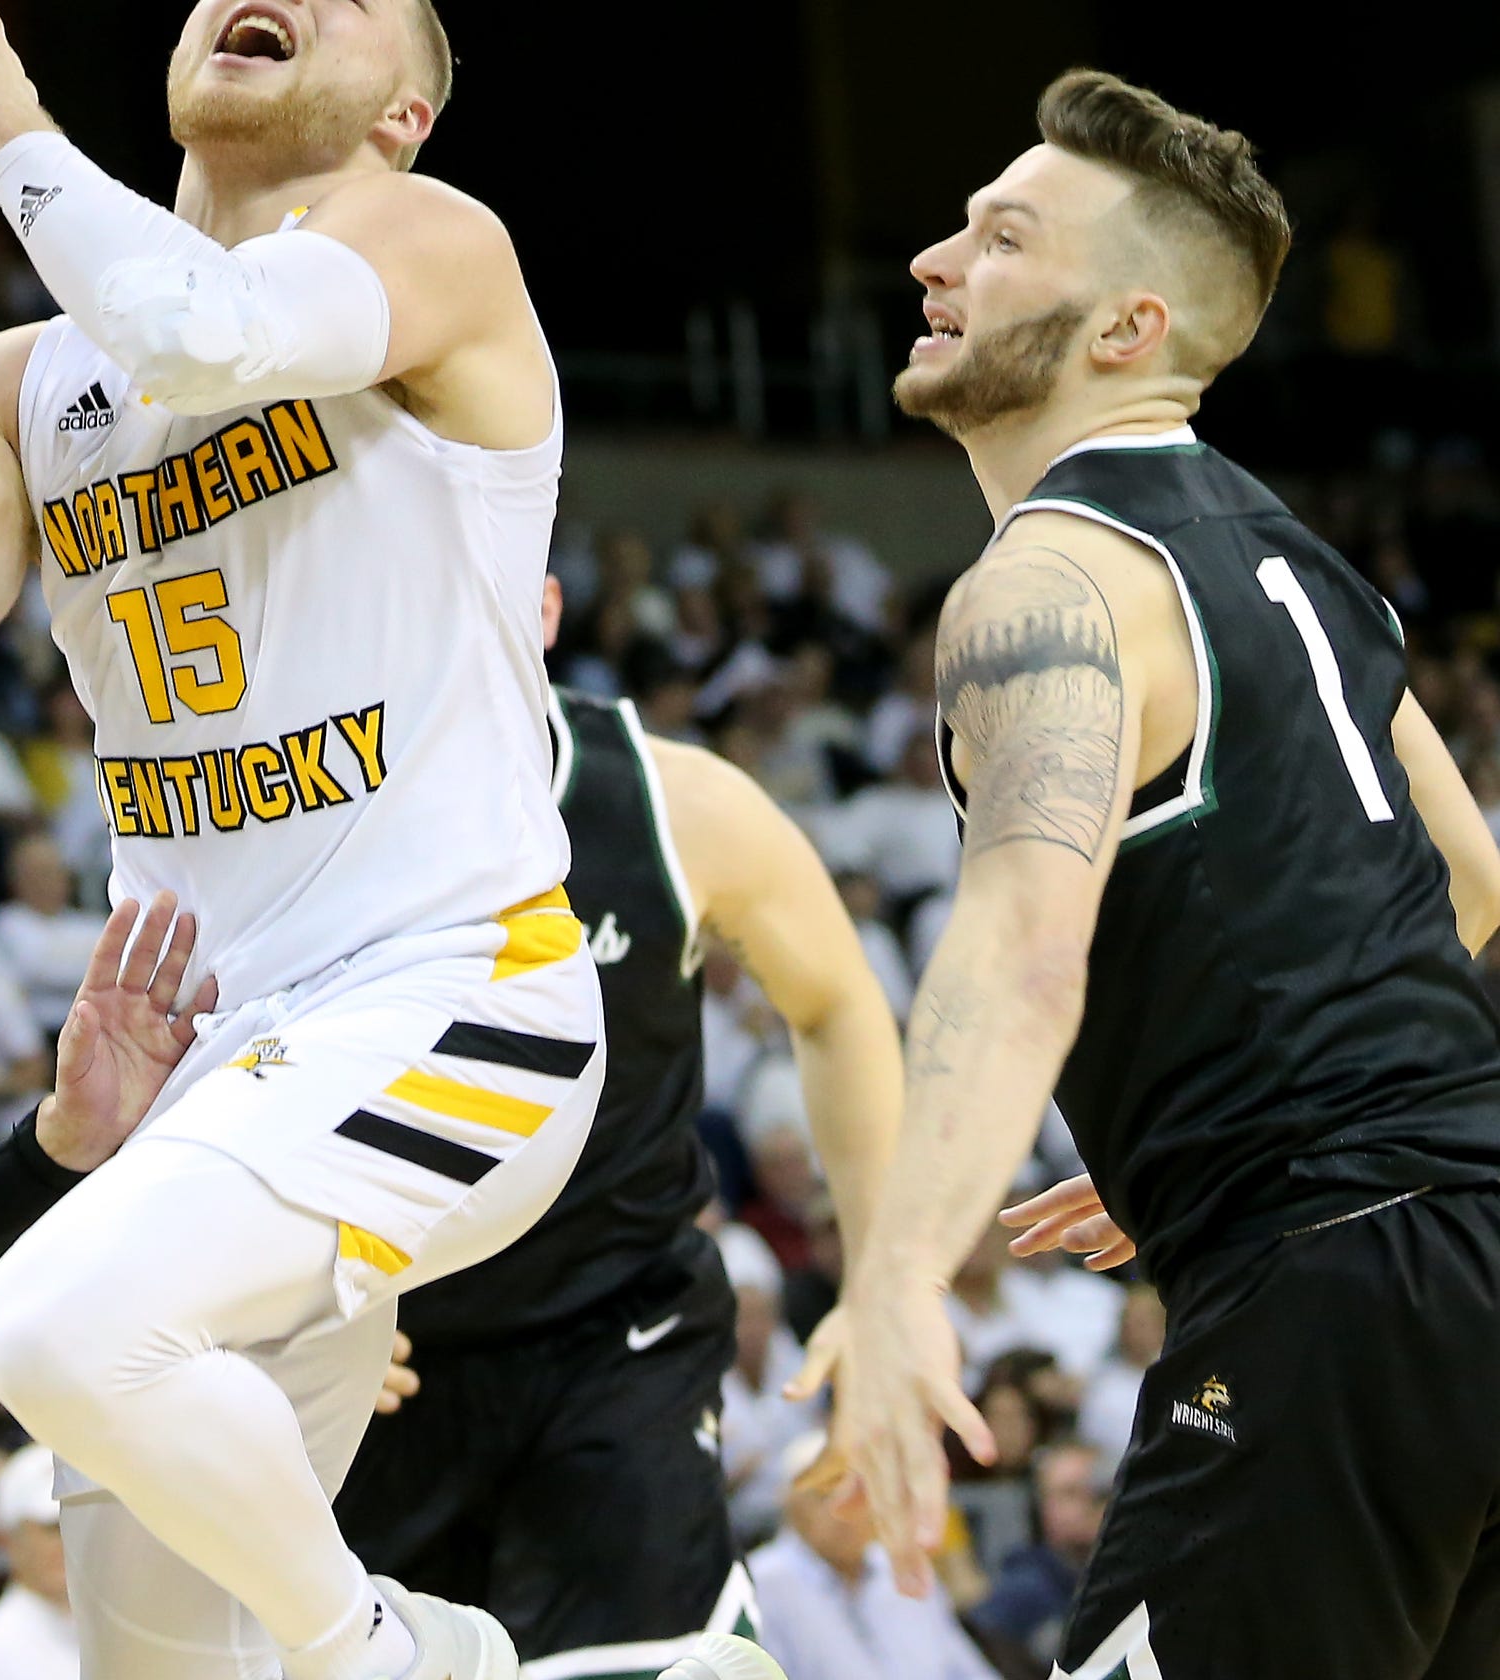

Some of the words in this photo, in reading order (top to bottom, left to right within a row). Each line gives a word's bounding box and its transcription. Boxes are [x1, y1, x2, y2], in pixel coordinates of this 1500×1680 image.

[23, 186, 63, 237] adidas
[43, 399, 338, 578] NORTHERN
[58, 409, 114, 431] adidas
[106, 568, 247, 724] 15
[1255, 555, 1395, 823] 1
[94, 700, 388, 838] ENTUCKY
[1172, 1400, 1214, 1431] WRIGHT
